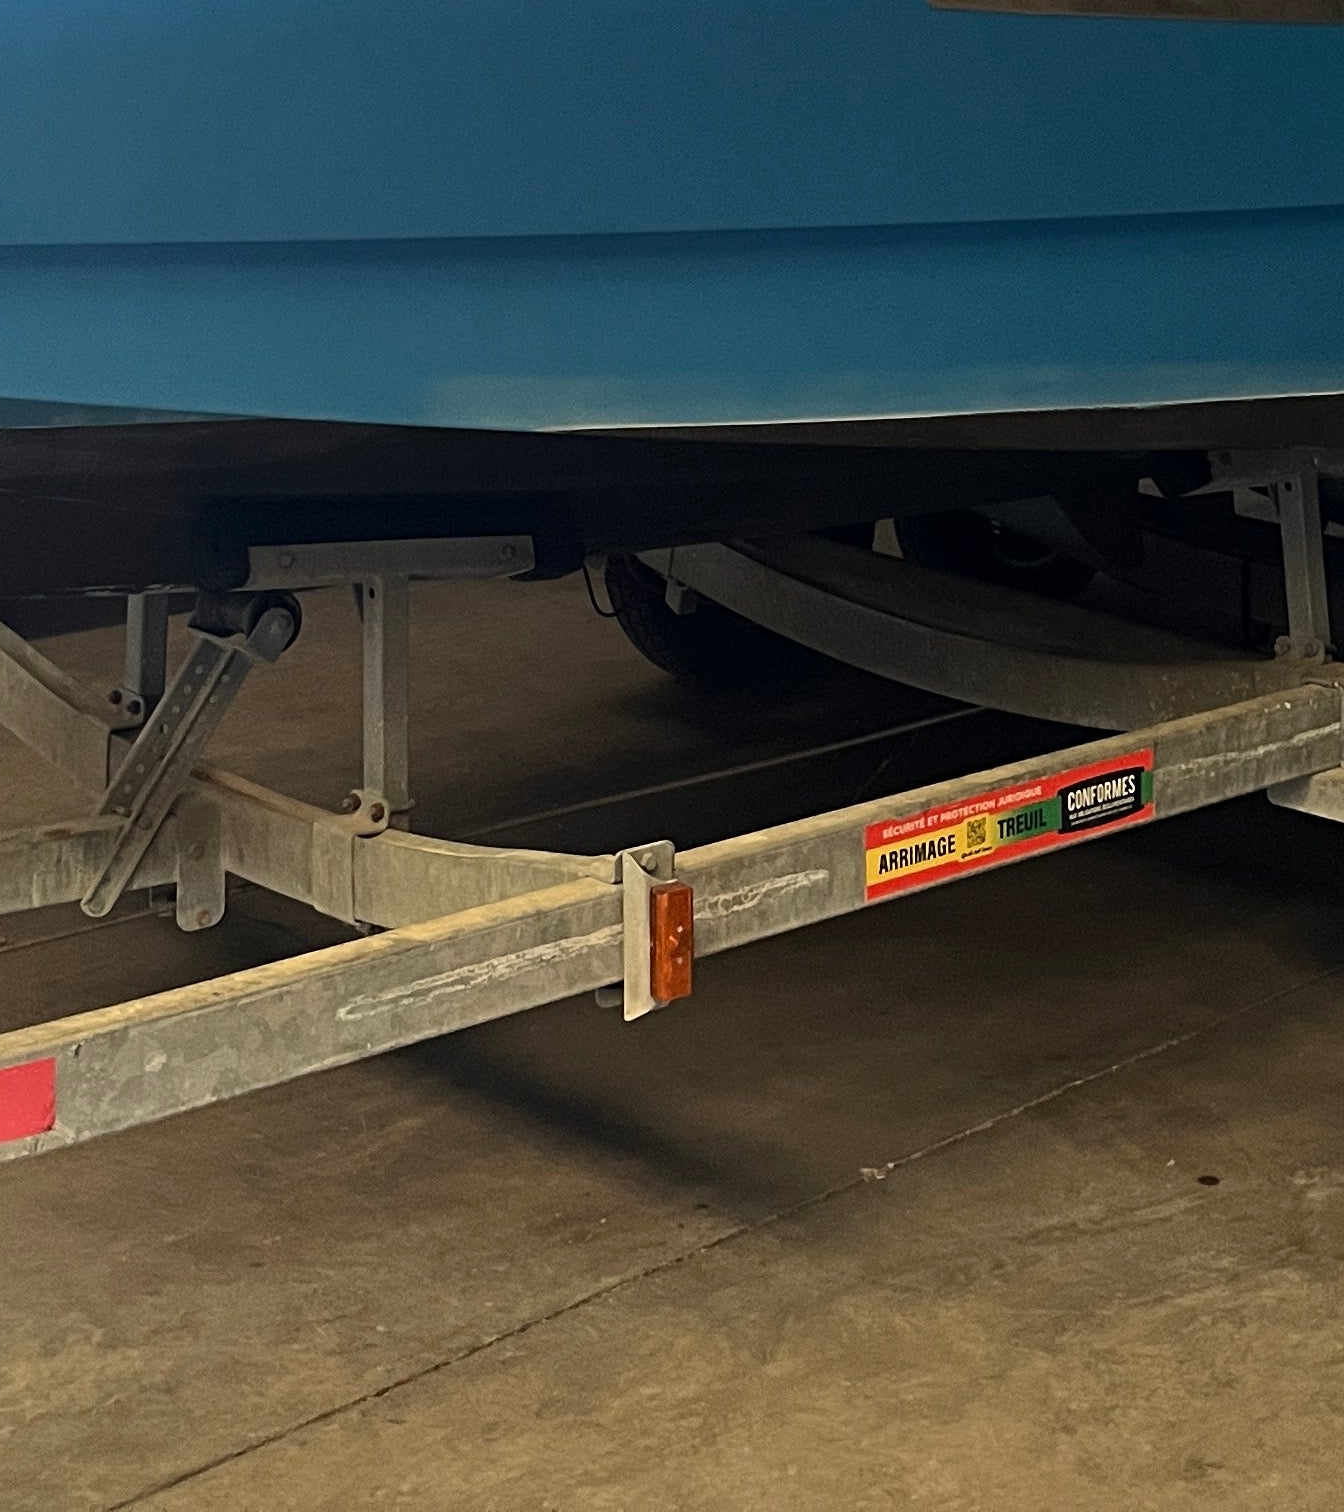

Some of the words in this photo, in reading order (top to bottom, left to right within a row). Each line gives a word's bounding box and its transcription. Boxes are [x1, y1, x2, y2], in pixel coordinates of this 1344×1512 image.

[1067, 774, 1136, 811] CONFORMES
[878, 834, 956, 875] ARRIMAGE
[997, 807, 1047, 840] TREUIL
